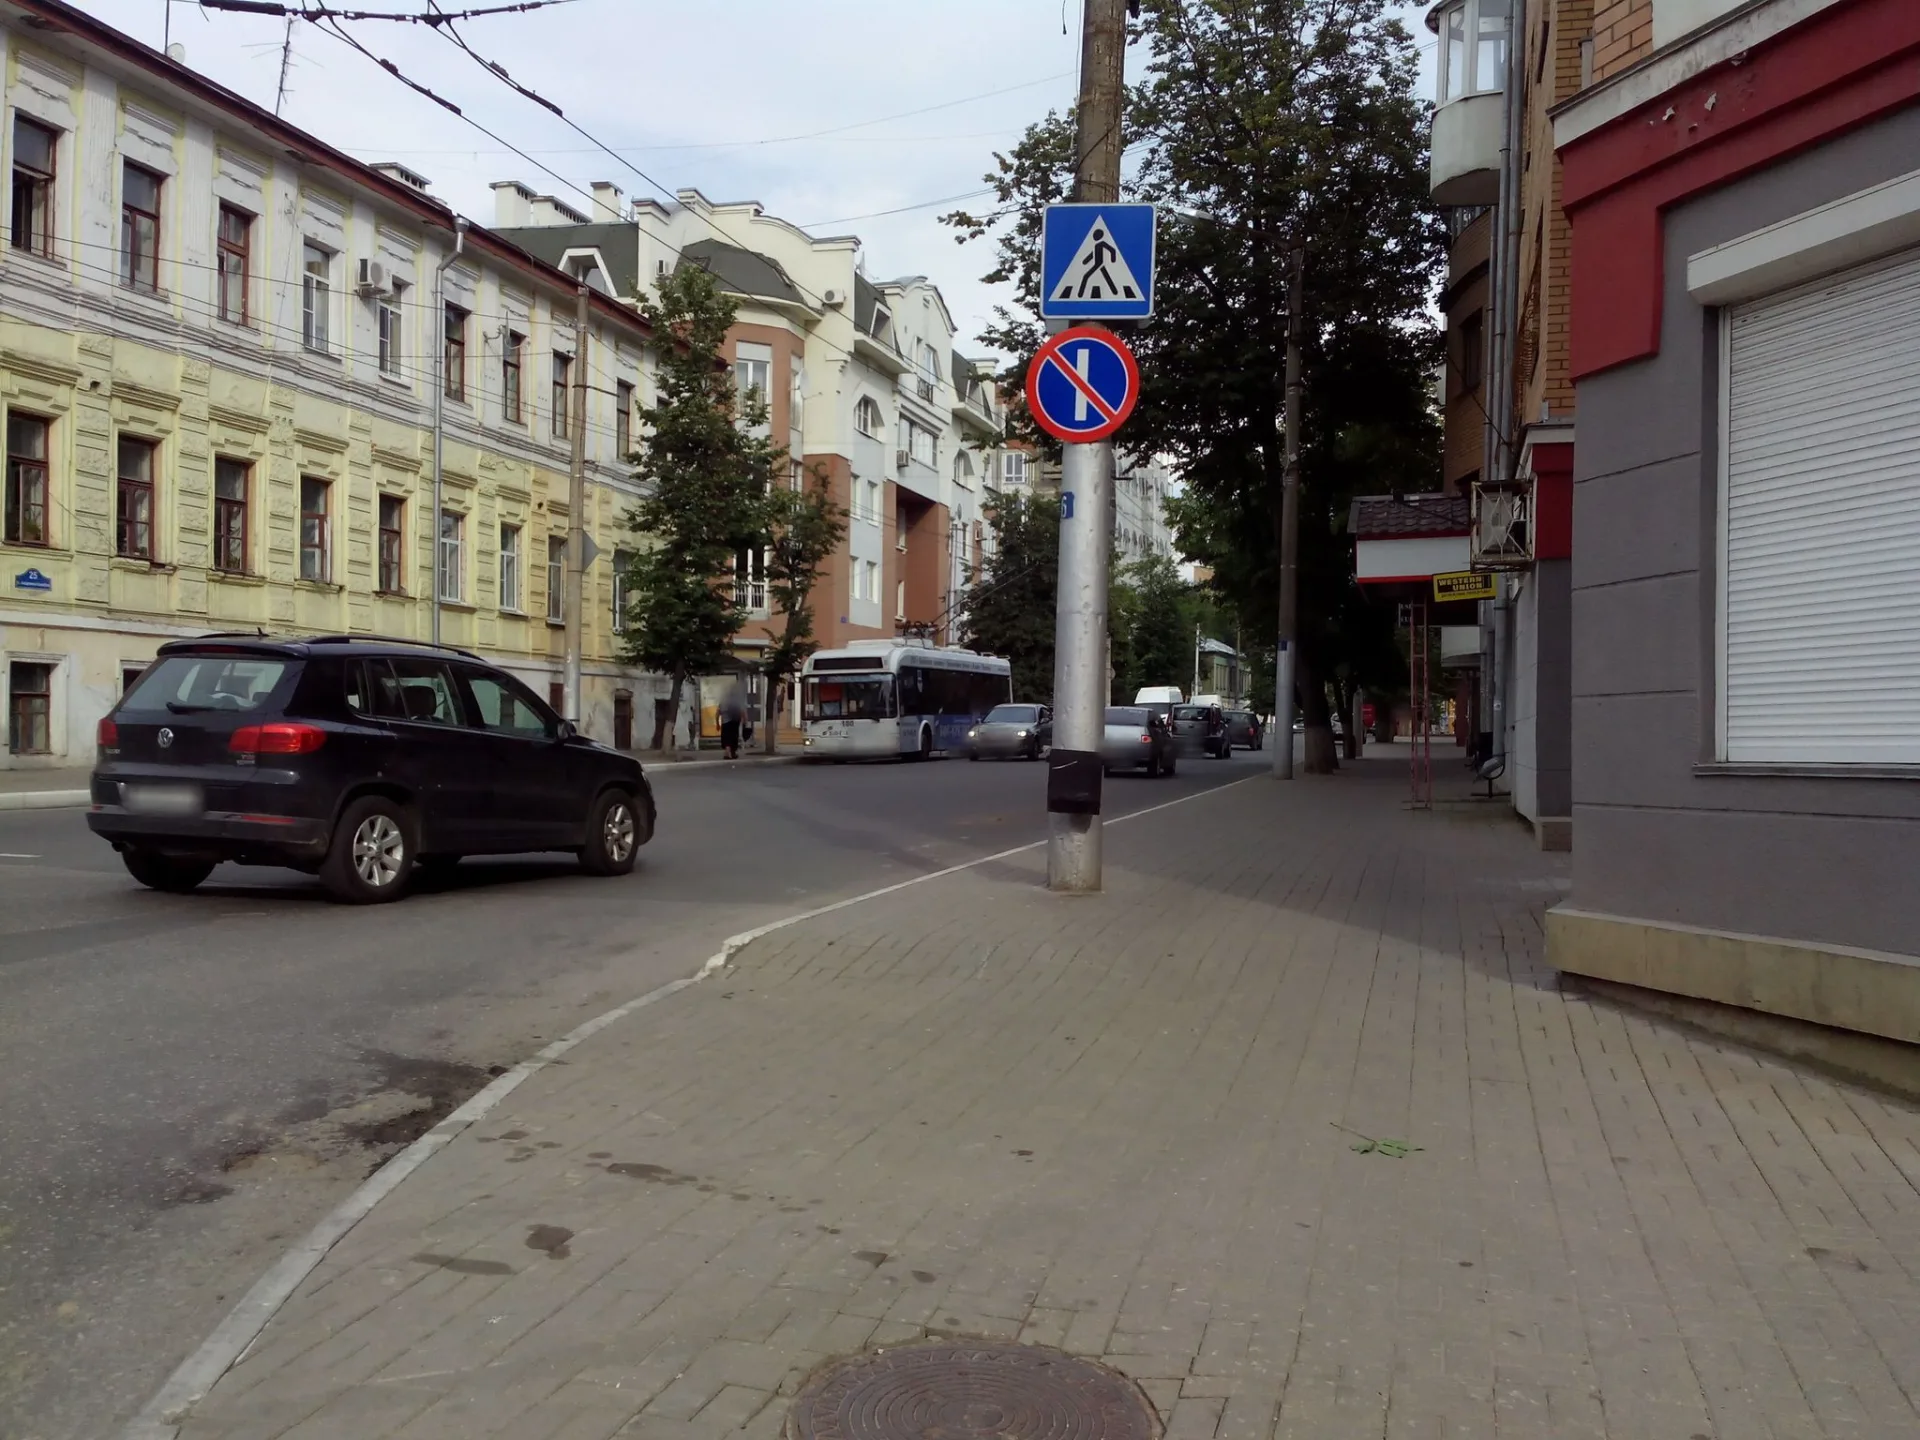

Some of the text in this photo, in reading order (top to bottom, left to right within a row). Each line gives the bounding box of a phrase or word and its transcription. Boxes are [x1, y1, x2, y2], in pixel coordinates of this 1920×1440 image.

[29, 571, 38, 579] 25
[1438, 576, 1482, 586] WESTERN
[1452, 583, 1482, 591] UNION
